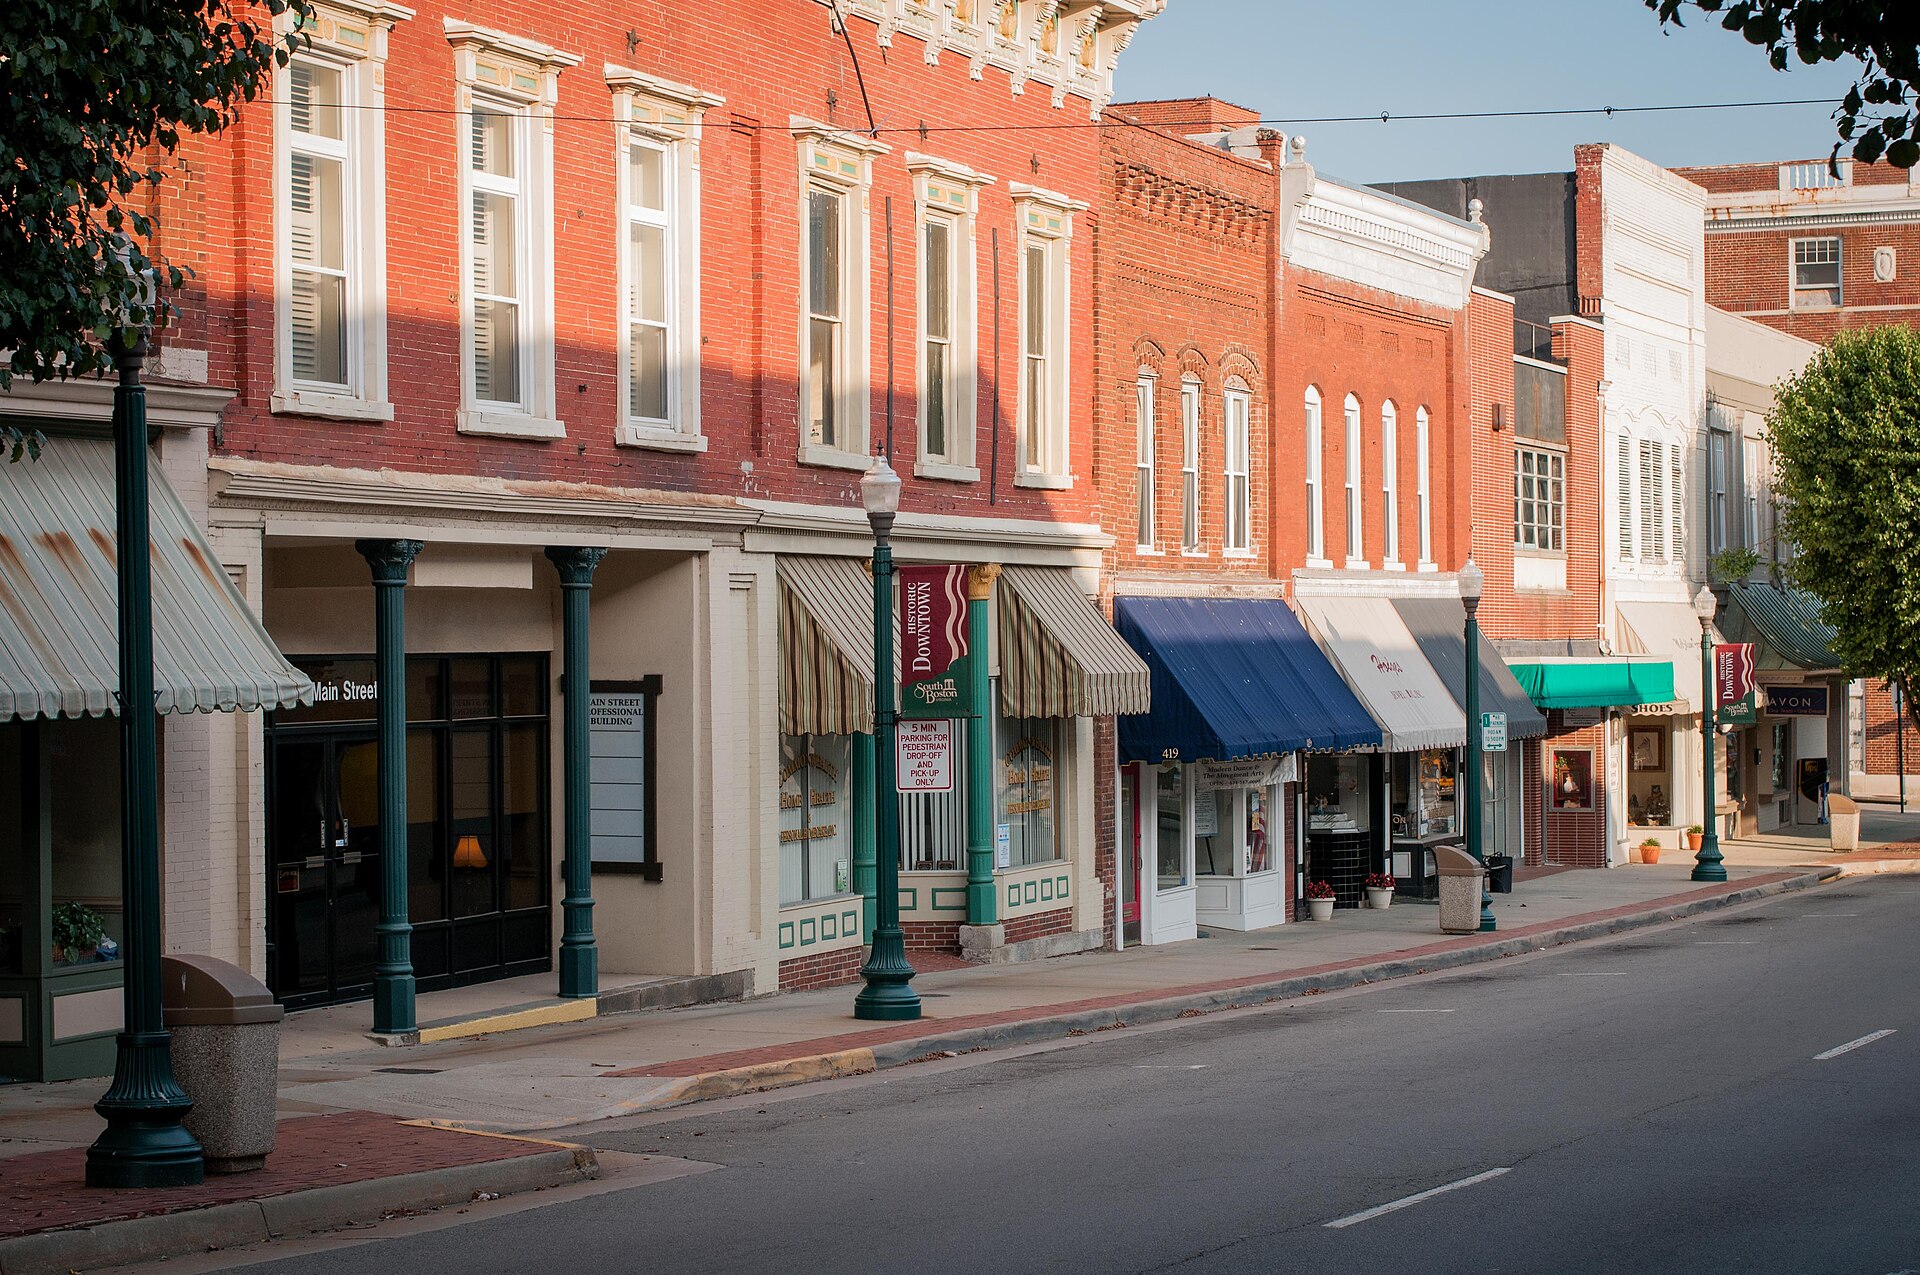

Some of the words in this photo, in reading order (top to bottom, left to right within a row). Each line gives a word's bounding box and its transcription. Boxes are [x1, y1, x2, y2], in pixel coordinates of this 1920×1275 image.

[908, 582, 916, 634] HISTORIC
[311, 681, 338, 701] Main
[914, 682, 943, 699] South
[925, 688, 958, 704] Boston
[1769, 697, 1811, 707] AVON
[1631, 704, 1673, 713] SHOES
[912, 723, 918, 732] 5
[920, 723, 937, 732] MIN
[900, 734, 932, 742] PARKING
[906, 752, 942, 760] DROP-OFF
[1162, 748, 1179, 759] 419
[910, 769, 939, 777] PICK-UP
